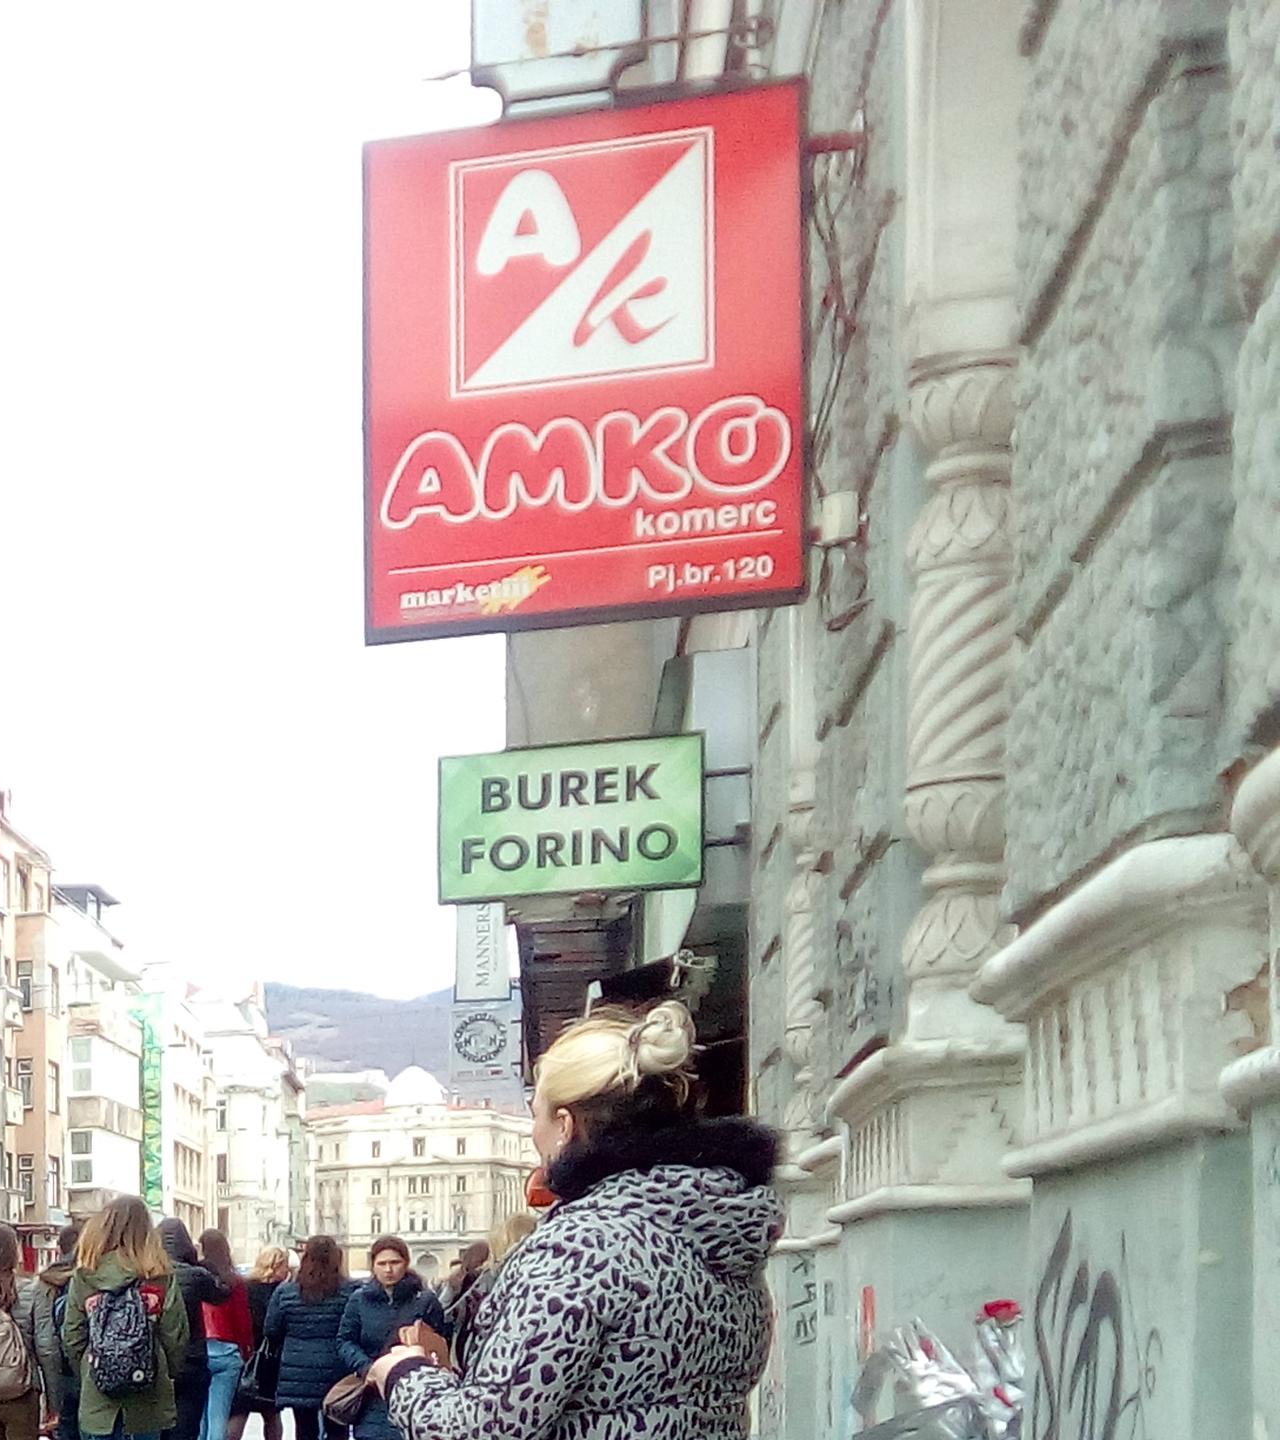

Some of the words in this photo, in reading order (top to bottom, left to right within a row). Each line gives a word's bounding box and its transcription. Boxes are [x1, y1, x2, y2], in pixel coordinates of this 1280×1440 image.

[477, 169, 581, 277] A
[381, 394, 792, 529] AMKO
[634, 499, 777, 538] komerc
[481, 763, 660, 814] BUREK
[461, 823, 678, 874] FORINO
[476, 902, 491, 987] MANNERS
